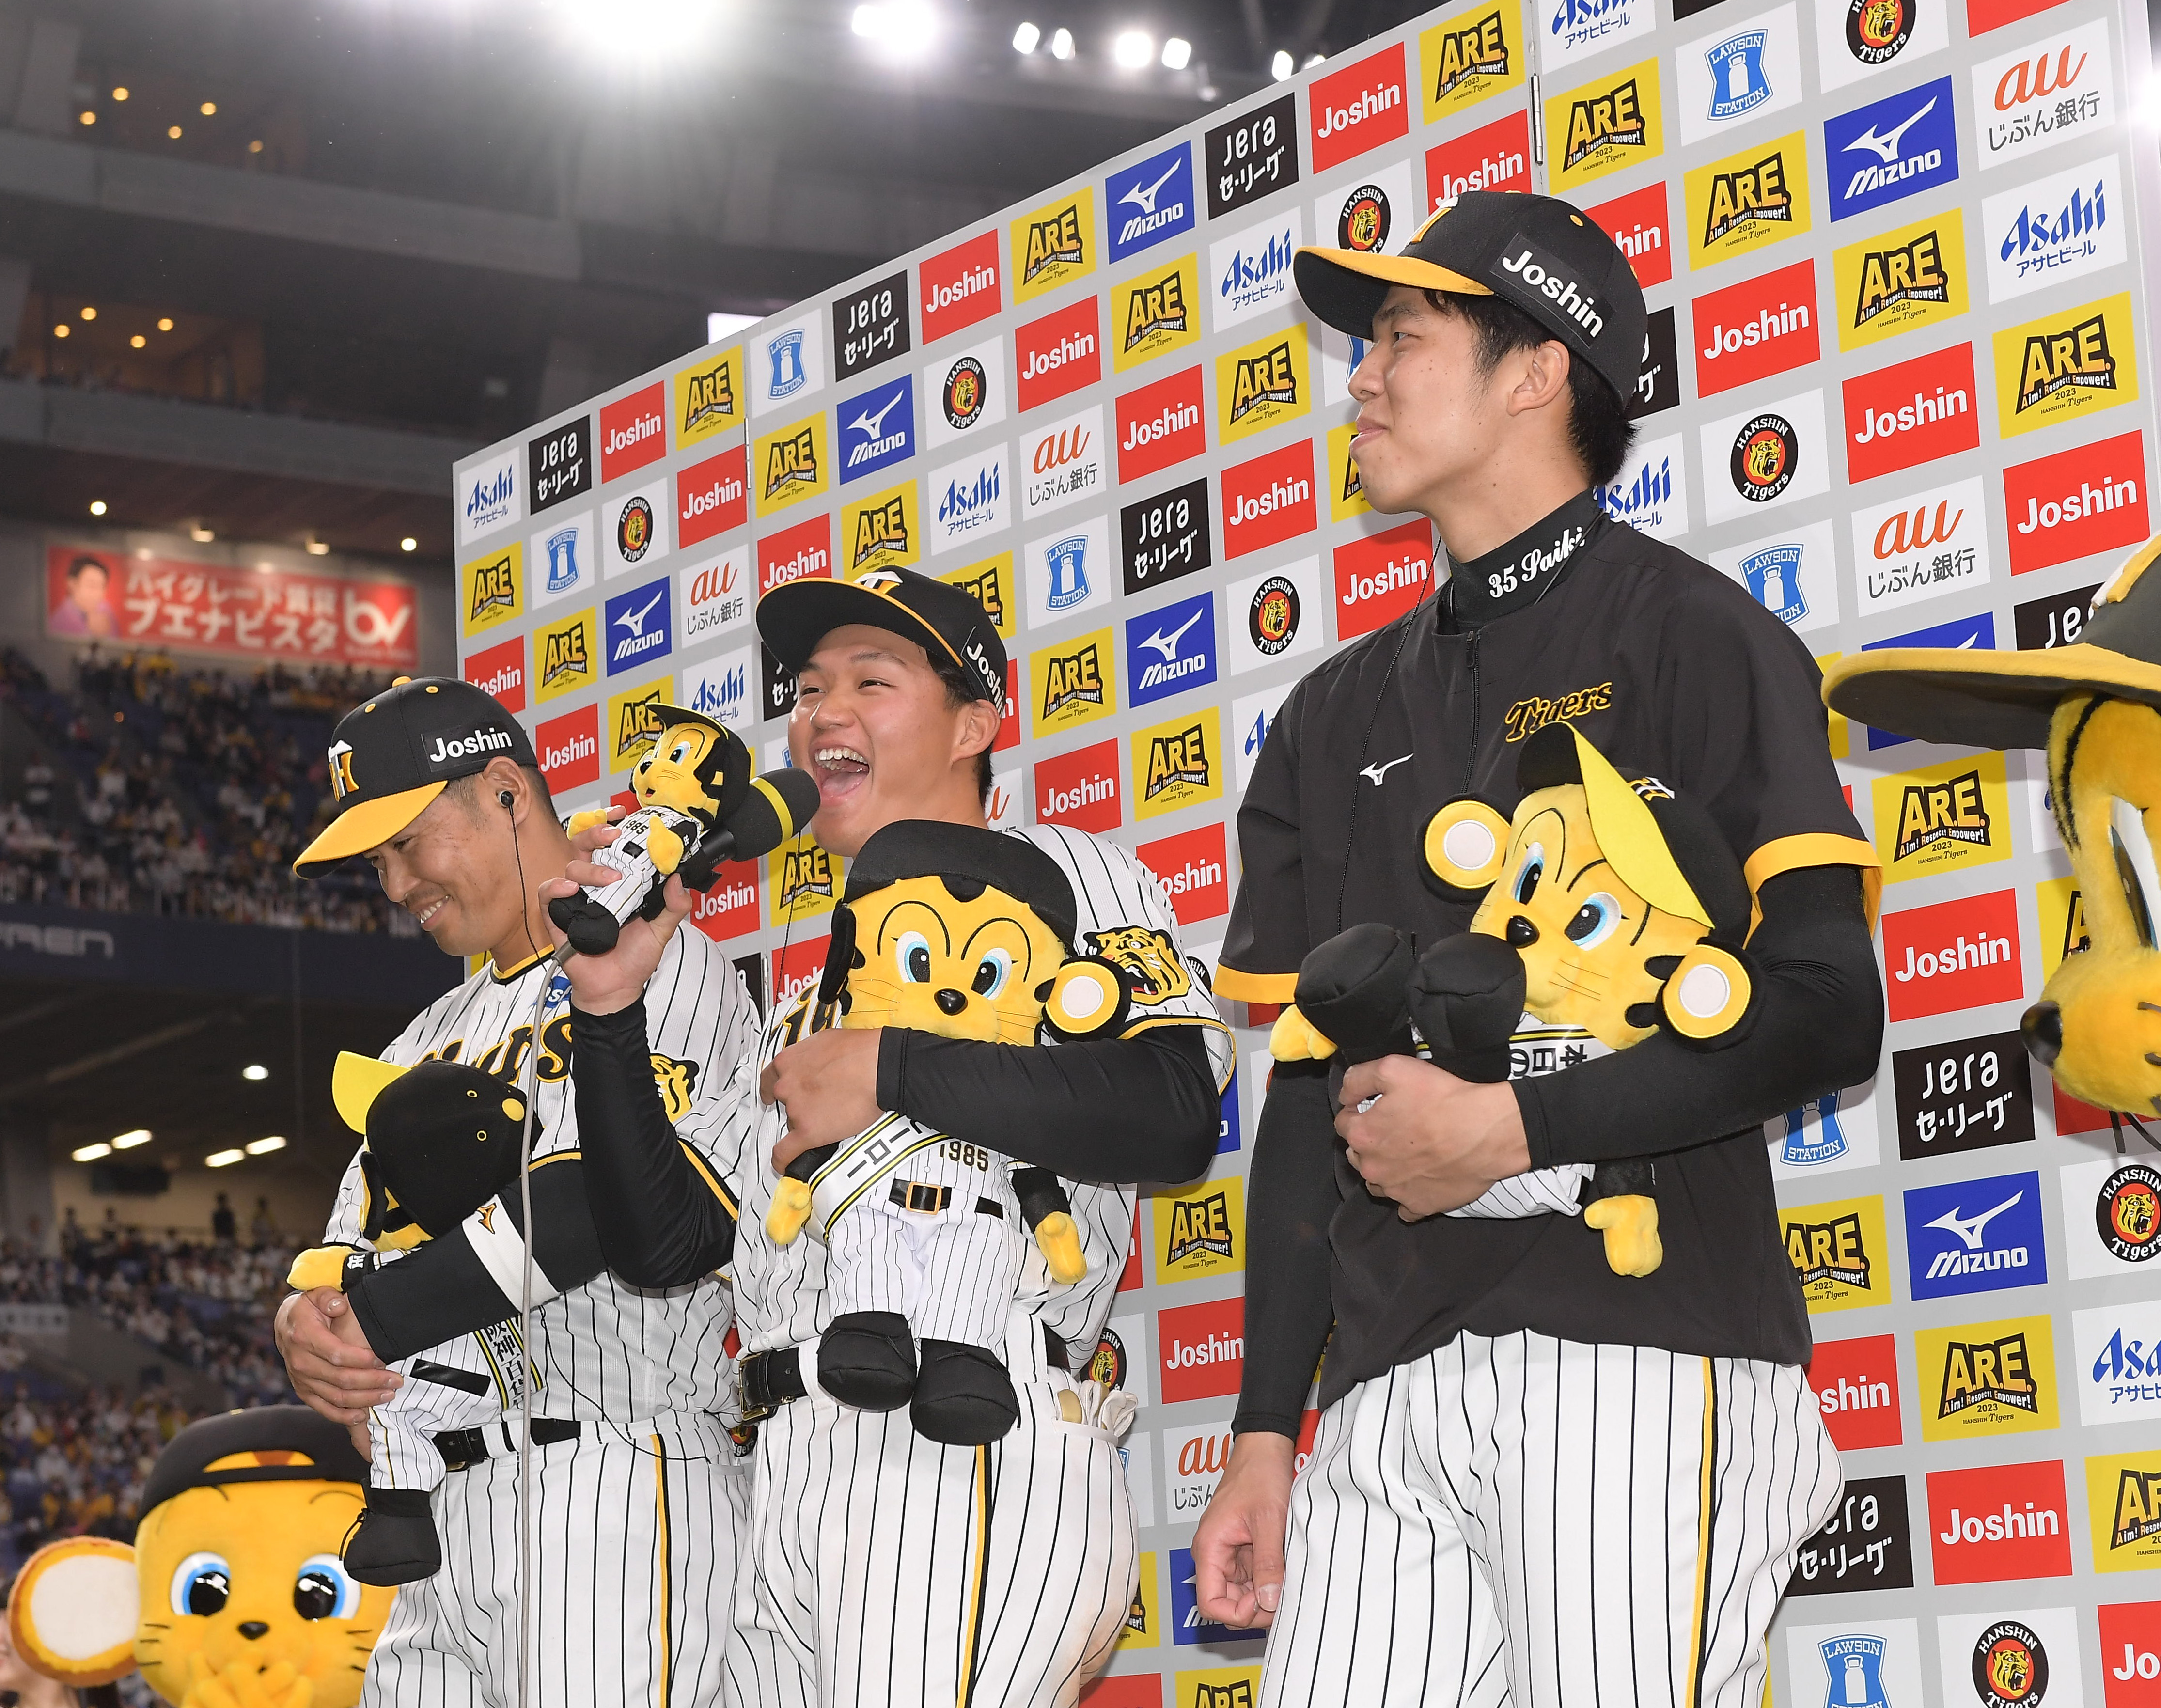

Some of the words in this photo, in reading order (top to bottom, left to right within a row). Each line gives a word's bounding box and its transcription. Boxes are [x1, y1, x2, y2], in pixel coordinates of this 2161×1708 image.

[1564, 10, 1630, 49] アサヒビール
[1710, 33, 1763, 66] LAWSON
[1858, 32, 1906, 64] Tigers
[1464, 76, 1480, 88] 2023
[1994, 45, 2086, 111] au
[1318, 81, 1400, 138] Joshin
[1715, 85, 1766, 116] STATION
[1988, 88, 2101, 151] じぶん銀行
[1595, 145, 1613, 158] 2023
[1605, 151, 1625, 163] Tigers
[1436, 149, 1522, 207] Joshin
[1343, 189, 1383, 219] HANSHIN
[2001, 179, 2105, 261] Asahi
[1738, 220, 1756, 234] 2023
[1749, 227, 1770, 239] Tigers
[1222, 228, 1291, 297] Asahi
[2016, 238, 2096, 278] アサヒビール
[927, 263, 994, 312] Joshin
[1232, 278, 1284, 311] アサヒビール
[1502, 250, 1603, 338] Joshin
[1860, 302, 1879, 323] Aim!
[1907, 286, 1942, 299] Empower!
[1891, 301, 1910, 314] 2023
[1903, 308, 1926, 320] Tigers
[771, 332, 802, 356] LAWSON
[1705, 300, 1809, 359] Joshin
[1023, 330, 1093, 379] Joshin
[773, 373, 804, 395] STATION
[947, 360, 980, 387] HANSHIN
[2021, 388, 2042, 409] Aim!
[2044, 376, 2070, 395] Respect!
[2072, 372, 2109, 386] Empower!
[2055, 387, 2076, 400] 2023
[2067, 394, 2092, 407] Tigers
[950, 405, 980, 429] Tigers
[1124, 400, 1198, 451] Joshin
[1855, 384, 1967, 444] Joshin
[606, 411, 661, 454] Joshin
[1737, 418, 1788, 450] HANSHIN
[1033, 424, 1089, 474] au
[468, 464, 512, 516] Asahi
[684, 476, 741, 519] Joshin
[939, 462, 998, 522] Asahi
[1029, 461, 1097, 505] じぶん銀行
[1593, 454, 1671, 519] sahi
[1743, 472, 1789, 501] Tigers
[474, 504, 508, 529] アサヒビール
[621, 500, 648, 523] HANSHIN
[1230, 475, 1309, 526] Joshin
[2018, 474, 2137, 534] Joshin
[947, 507, 993, 536] アサヒビール
[1873, 500, 1962, 560] au
[549, 531, 576, 552] LAWSON
[624, 540, 648, 562] Tigers
[1049, 539, 1084, 563] LAWSON
[765, 546, 826, 589] Joshin
[1488, 564, 1518, 598] 35
[1521, 526, 1585, 582] Saiki
[1745, 548, 1799, 576] LAWSON
[1867, 546, 1975, 598] じぶん銀行
[550, 570, 577, 590] STATION
[691, 562, 737, 606] au
[1051, 584, 1086, 607] STATION
[1254, 580, 1293, 608] HANSHIN
[1343, 554, 1427, 605] Joshin
[687, 596, 743, 635] じぶん銀行
[1258, 629, 1293, 655] Tigers
[691, 663, 743, 717] Asahi
[966, 642, 1006, 718] Joshin
[429, 727, 513, 762] Joshin
[541, 733, 595, 771] Joshin
[1042, 772, 1113, 817] Joshin
[626, 820, 649, 834] 985
[1900, 838, 1919, 857] Aim!
[1949, 828, 1984, 842] Empower!
[1932, 840, 1952, 851] 2023
[1944, 849, 1968, 859] Tigers
[695, 880, 754, 919] Joshin
[1896, 930, 2011, 982] Joshin
[939, 1140, 988, 1172] 1985
[1788, 1138, 1842, 1160] STATION
[2103, 1169, 2161, 1200] HANSHIN
[2111, 1235, 2161, 1261] Tigers
[1814, 1281, 1833, 1290] 2023
[1830, 1269, 1864, 1285] Empower!
[1826, 1291, 1848, 1299] Tigers
[1167, 1330, 1245, 1369] Joshin
[1814, 1375, 1890, 1415] shin
[1944, 1397, 1964, 1414] Aim!
[1966, 1391, 1992, 1405] Respect!
[1994, 1390, 2030, 1408] Empower!
[1976, 1403, 1998, 1412] 2023
[1989, 1413, 2014, 1422] Tigers
[1178, 1433, 1230, 1476] au
[1940, 1501, 2059, 1545] Joshin
[2116, 1527, 2138, 1545] Aim!
[1824, 1641, 1881, 1660] LAWSON
[1978, 1625, 2037, 1655] HANSHIN
